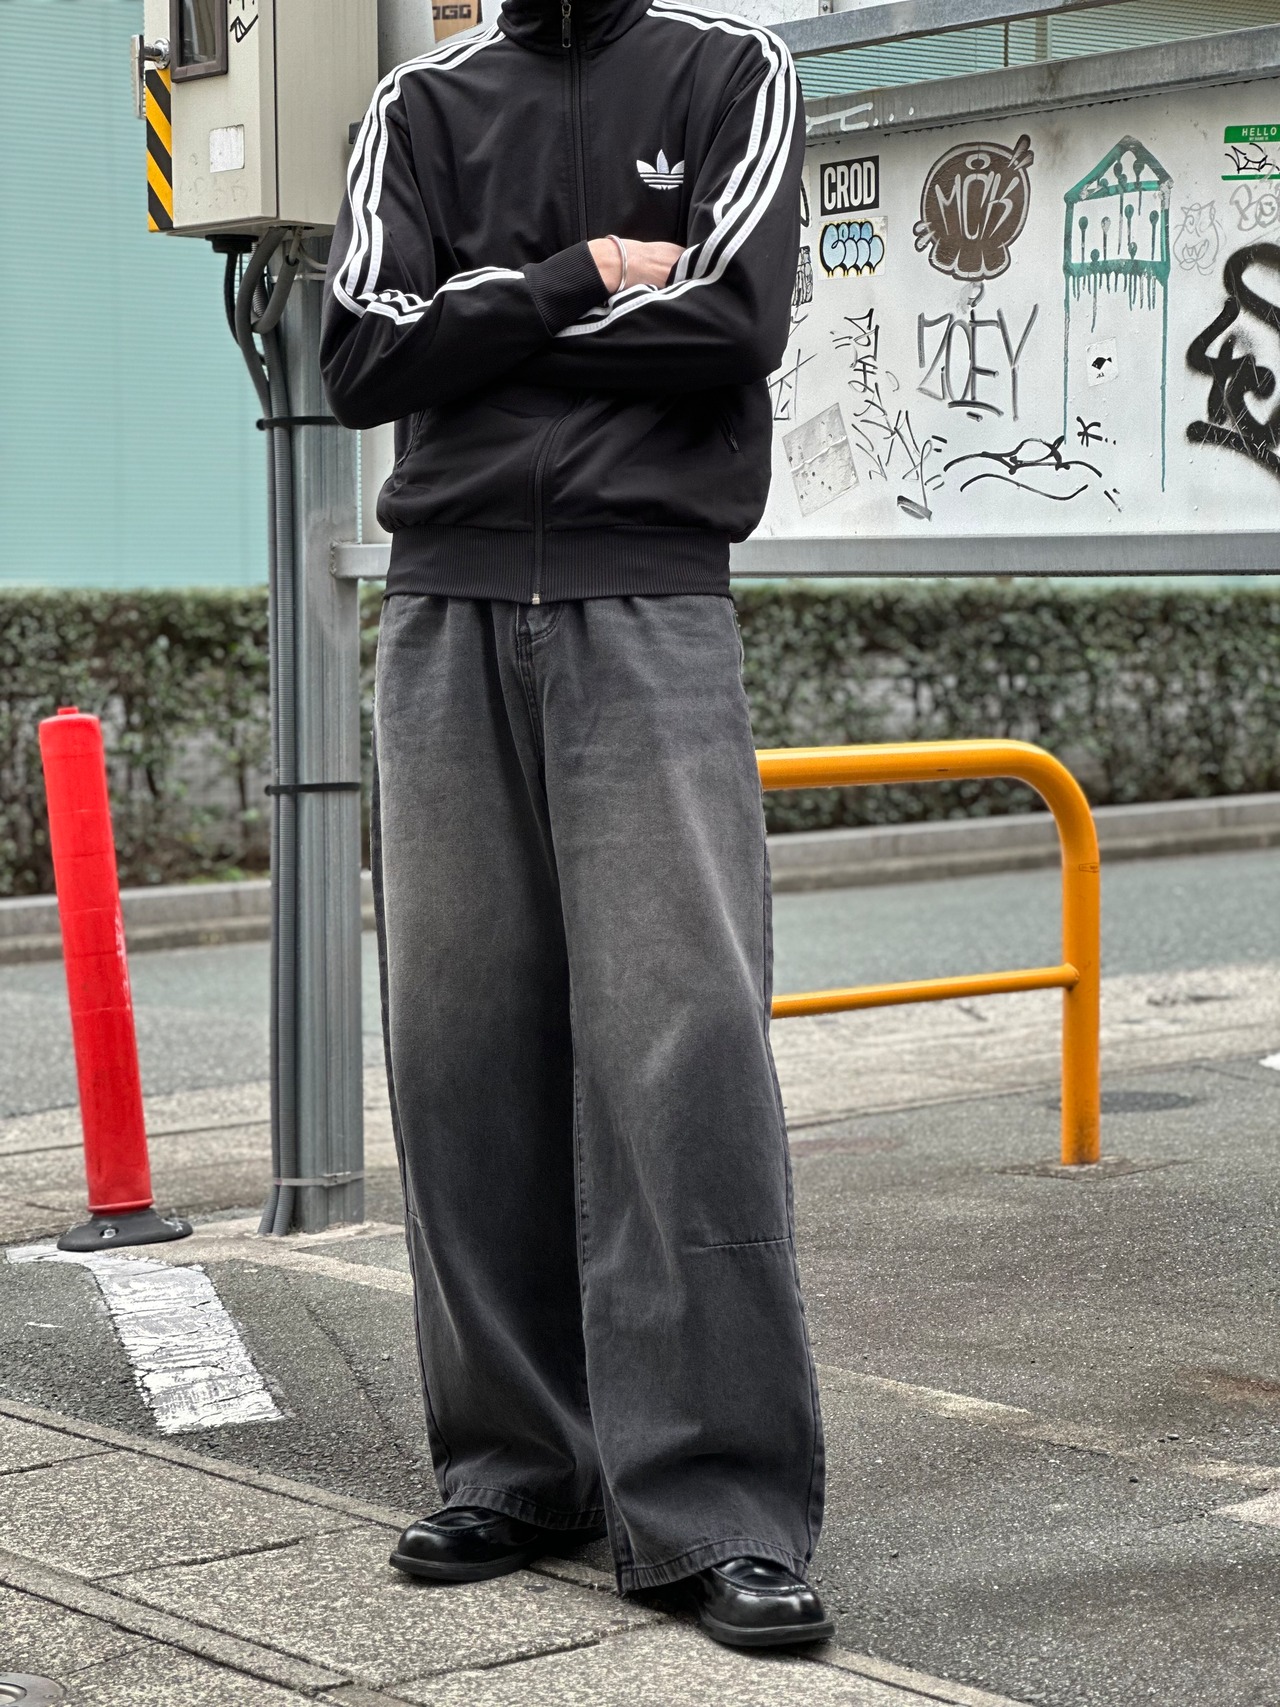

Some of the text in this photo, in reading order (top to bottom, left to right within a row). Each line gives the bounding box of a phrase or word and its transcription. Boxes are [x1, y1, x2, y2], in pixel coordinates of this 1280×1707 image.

[1241, 127, 1277, 137] HELLO
[823, 160, 876, 211] CROD
[916, 303, 1039, 421] ZOEY
